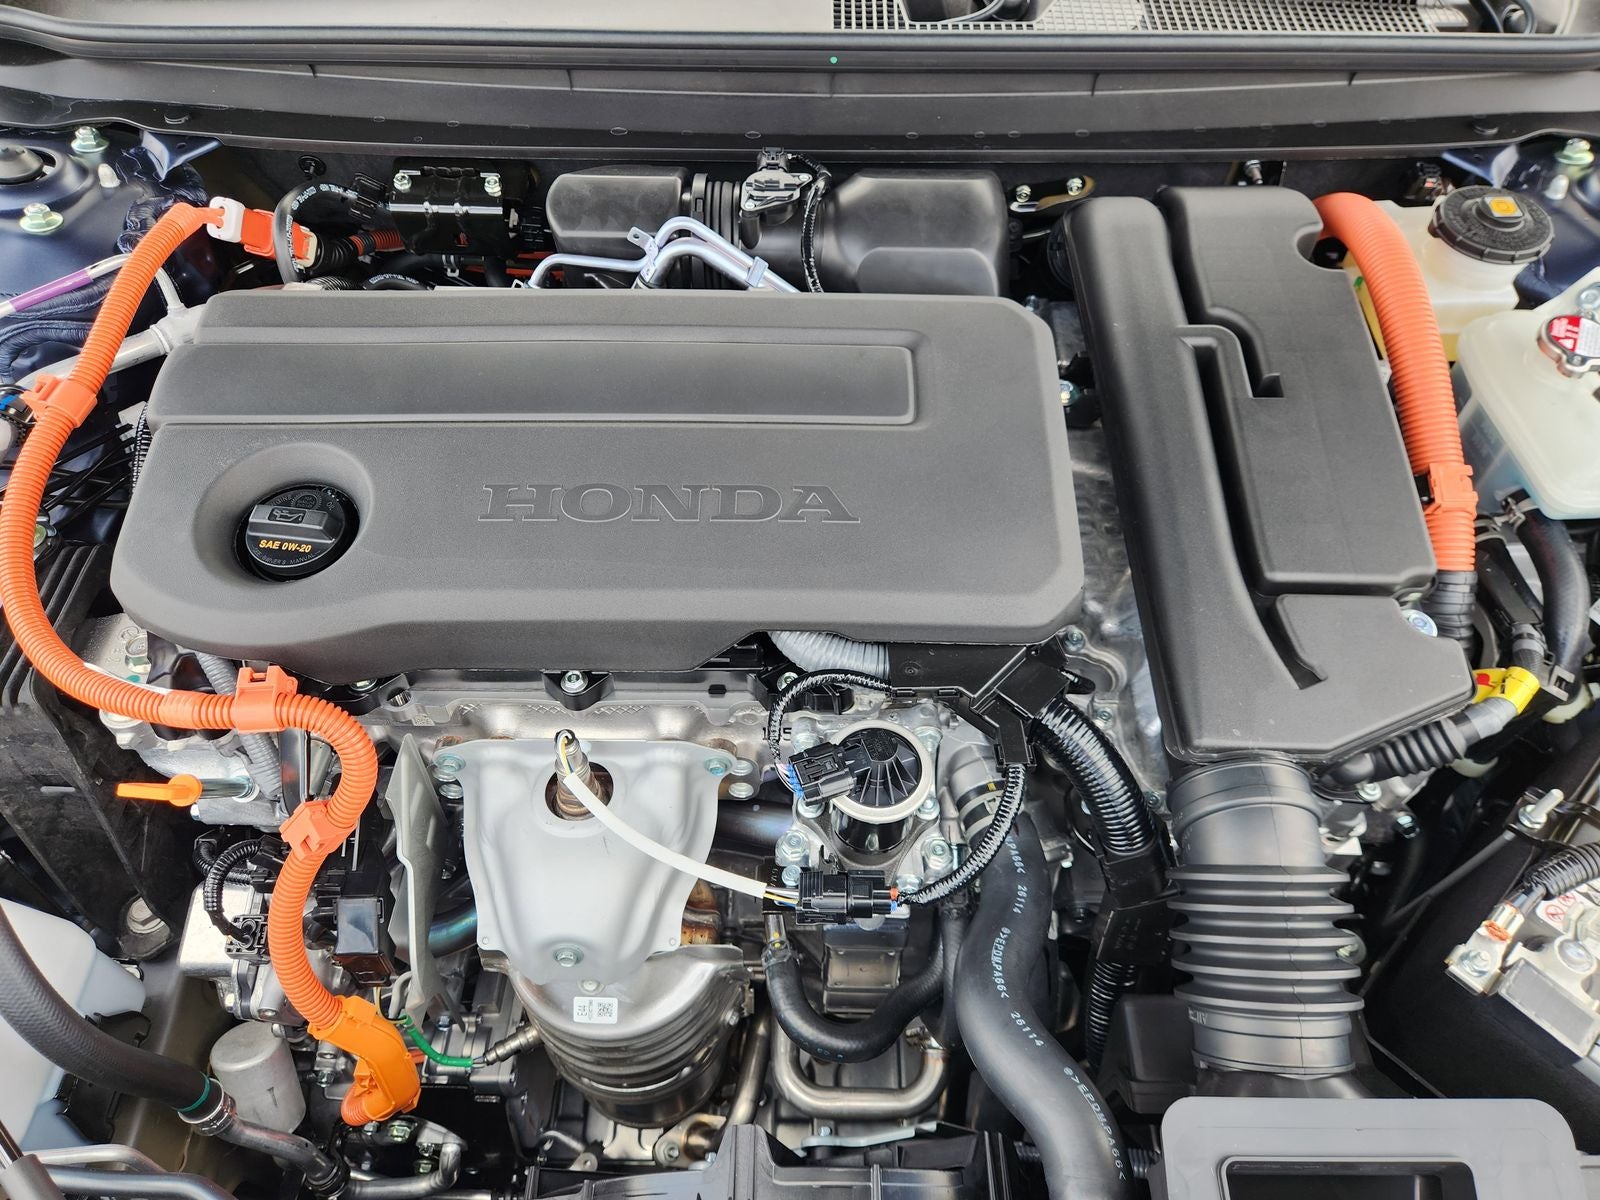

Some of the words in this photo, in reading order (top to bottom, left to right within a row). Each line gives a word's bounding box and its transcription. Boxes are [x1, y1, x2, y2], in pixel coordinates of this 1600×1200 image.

[478, 483, 860, 523] HONDA
[259, 540, 281, 550] SAE
[282, 542, 312, 553] 0W-20
[1010, 1011, 1044, 1046] 26114
